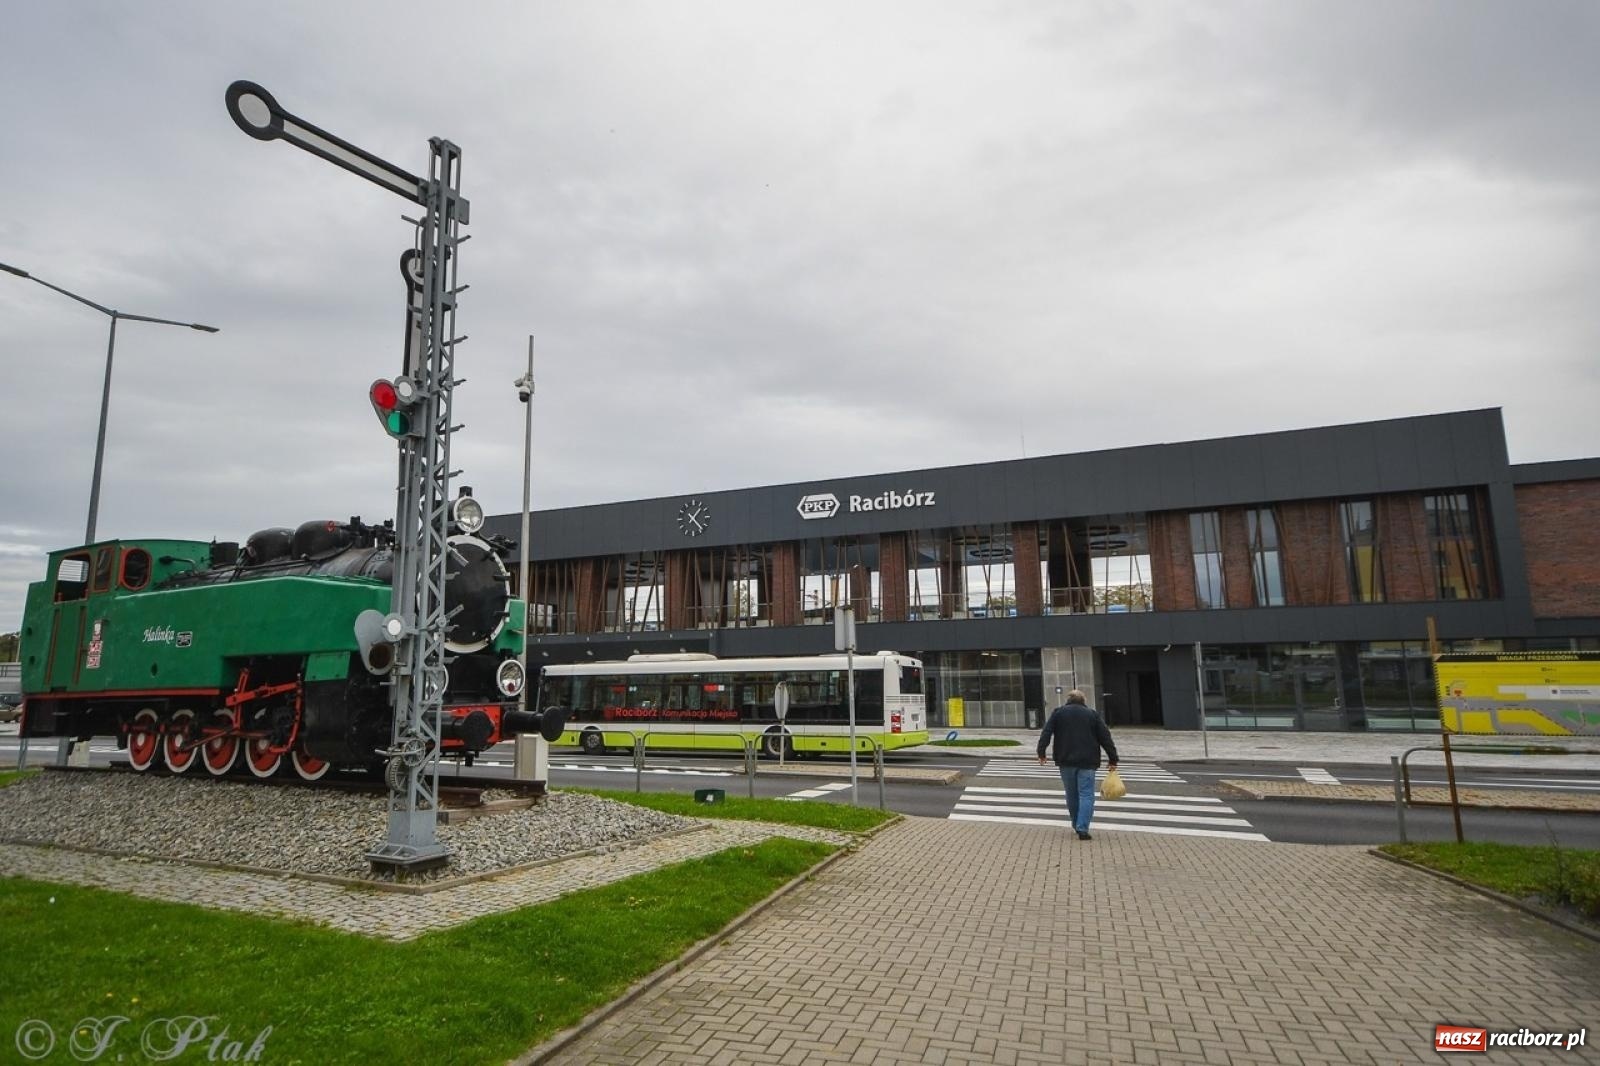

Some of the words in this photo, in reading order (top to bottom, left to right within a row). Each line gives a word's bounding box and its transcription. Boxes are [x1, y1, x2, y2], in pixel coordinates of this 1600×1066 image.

[803, 500, 834, 512] PKP
[849, 488, 935, 512] Racibórz
[142, 625, 174, 644] Halinka
